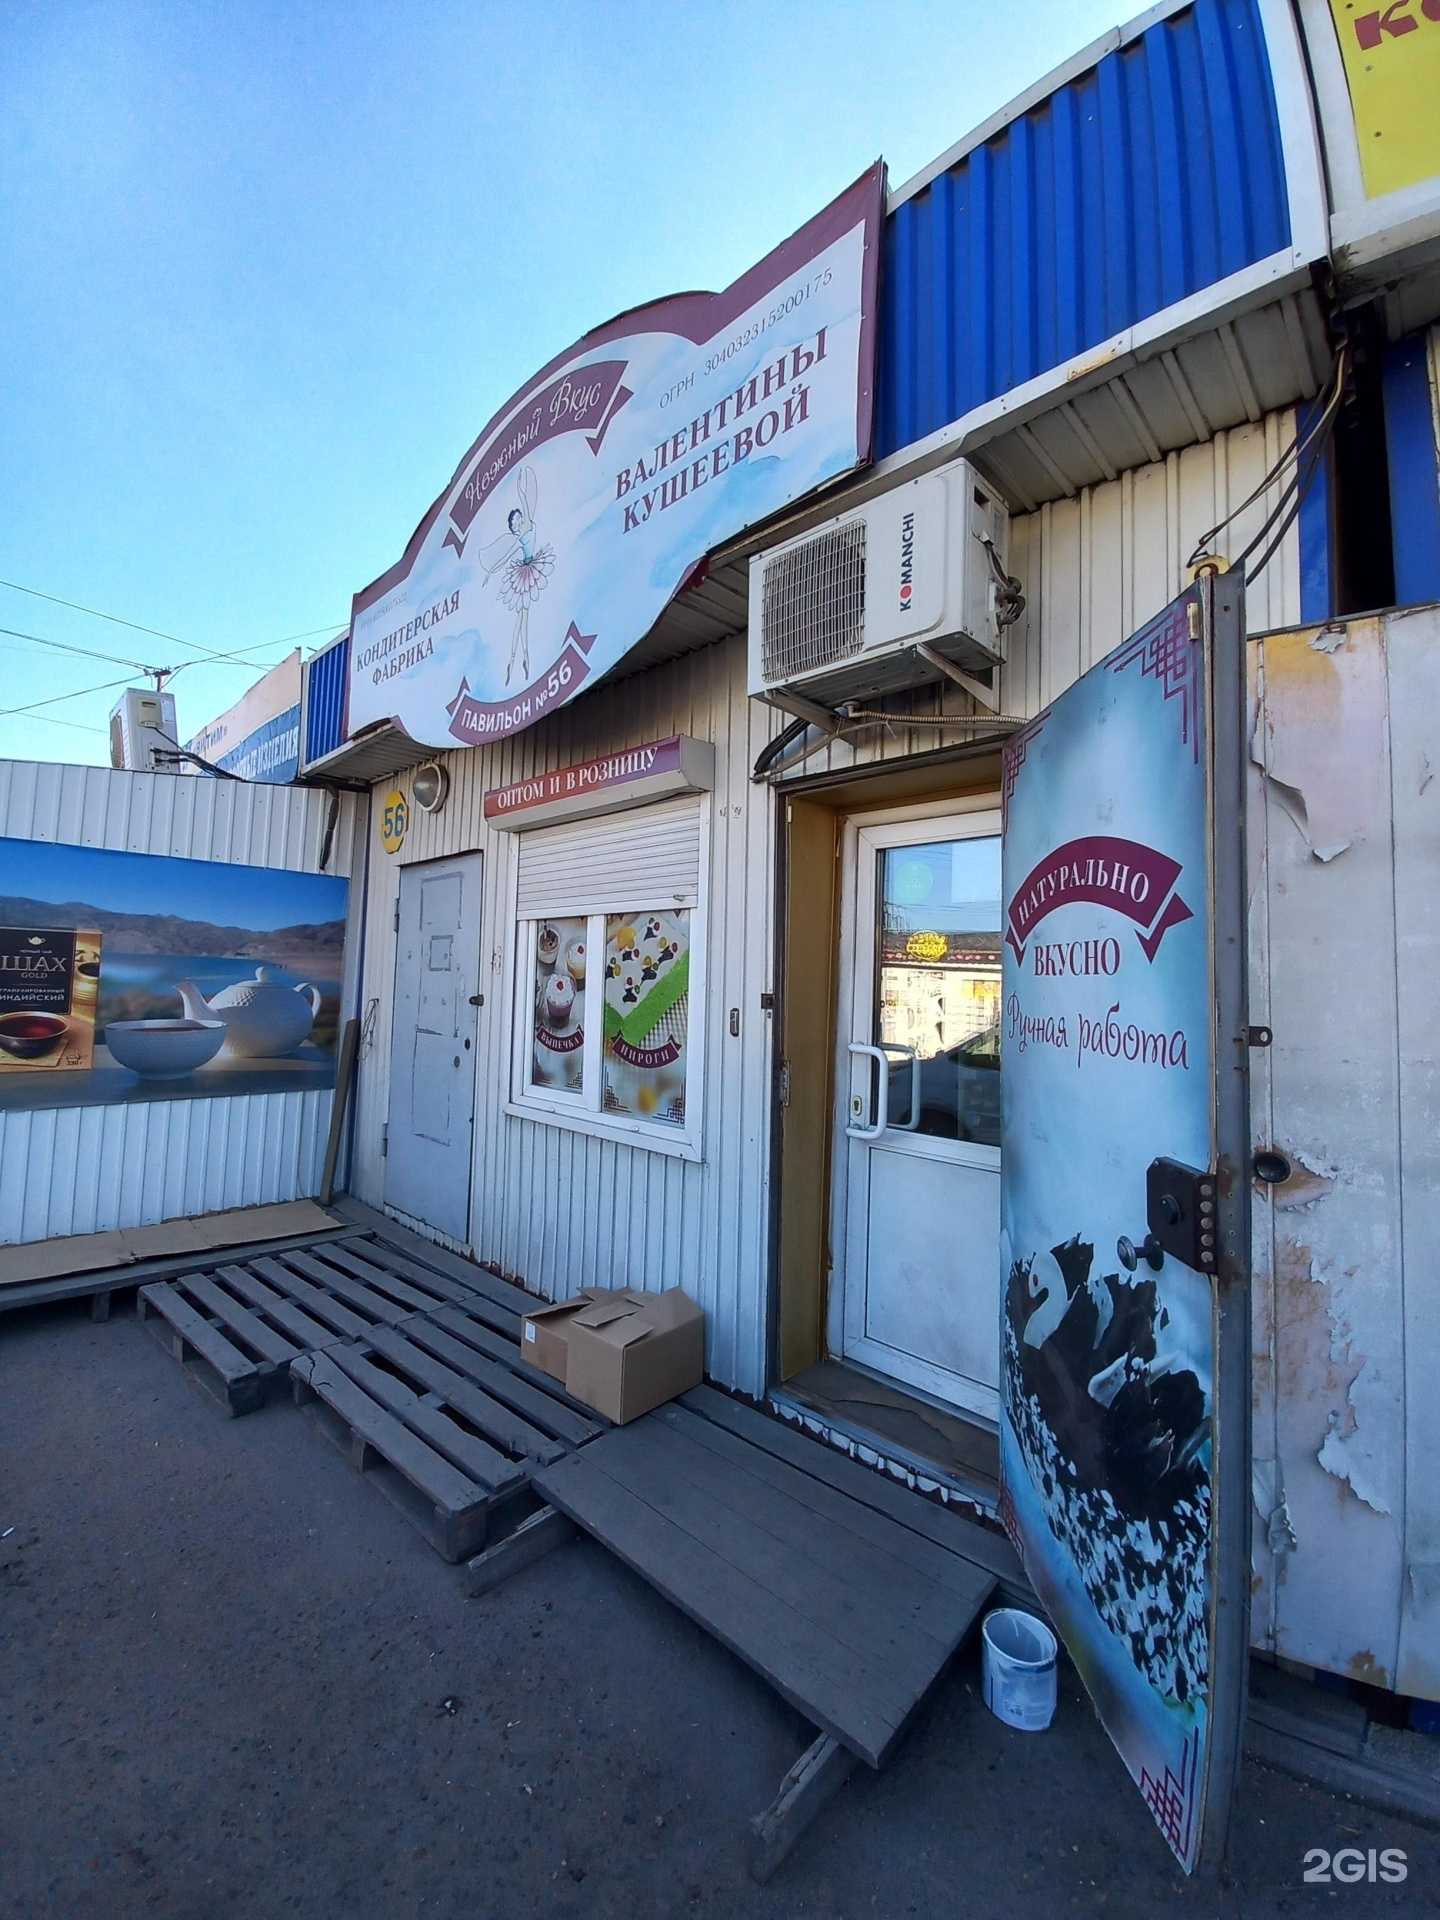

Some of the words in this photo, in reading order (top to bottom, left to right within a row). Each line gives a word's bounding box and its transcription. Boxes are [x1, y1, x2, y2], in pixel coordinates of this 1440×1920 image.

[659, 371, 695, 409] ОГРН
[703, 267, 832, 376] 304032315200175
[465, 407, 542, 511] Нежный
[550, 375, 601, 426] Вкус
[616, 326, 828, 500] ВАЛЕНТИНЫ
[622, 383, 811, 534] КУШЕЕВОЙ
[900, 512, 915, 612] KOMANCHI
[357, 589, 460, 672] КОНДИТЕРСКАЯ
[372, 636, 434, 686] ФАБРИКА
[461, 699, 532, 733] ПАВИЛЬОН
[497, 781, 544, 808] ОПТОМ
[550, 776, 561, 794] И
[566, 772, 577, 791] В
[579, 747, 659, 787] РОЗНИЦУ
[383, 804, 405, 839] 56
[1018, 859, 1150, 926] НАТУРАЛЬНО
[20, 971, 48, 979] GOLD
[1034, 937, 1121, 976] ВКУСНО
[540, 1032, 581, 1050] ВЫПЕЧКА
[620, 1045, 670, 1065] ПИРОГИ
[1007, 992, 1068, 1053] Ручная
[1078, 1001, 1190, 1070] работа
